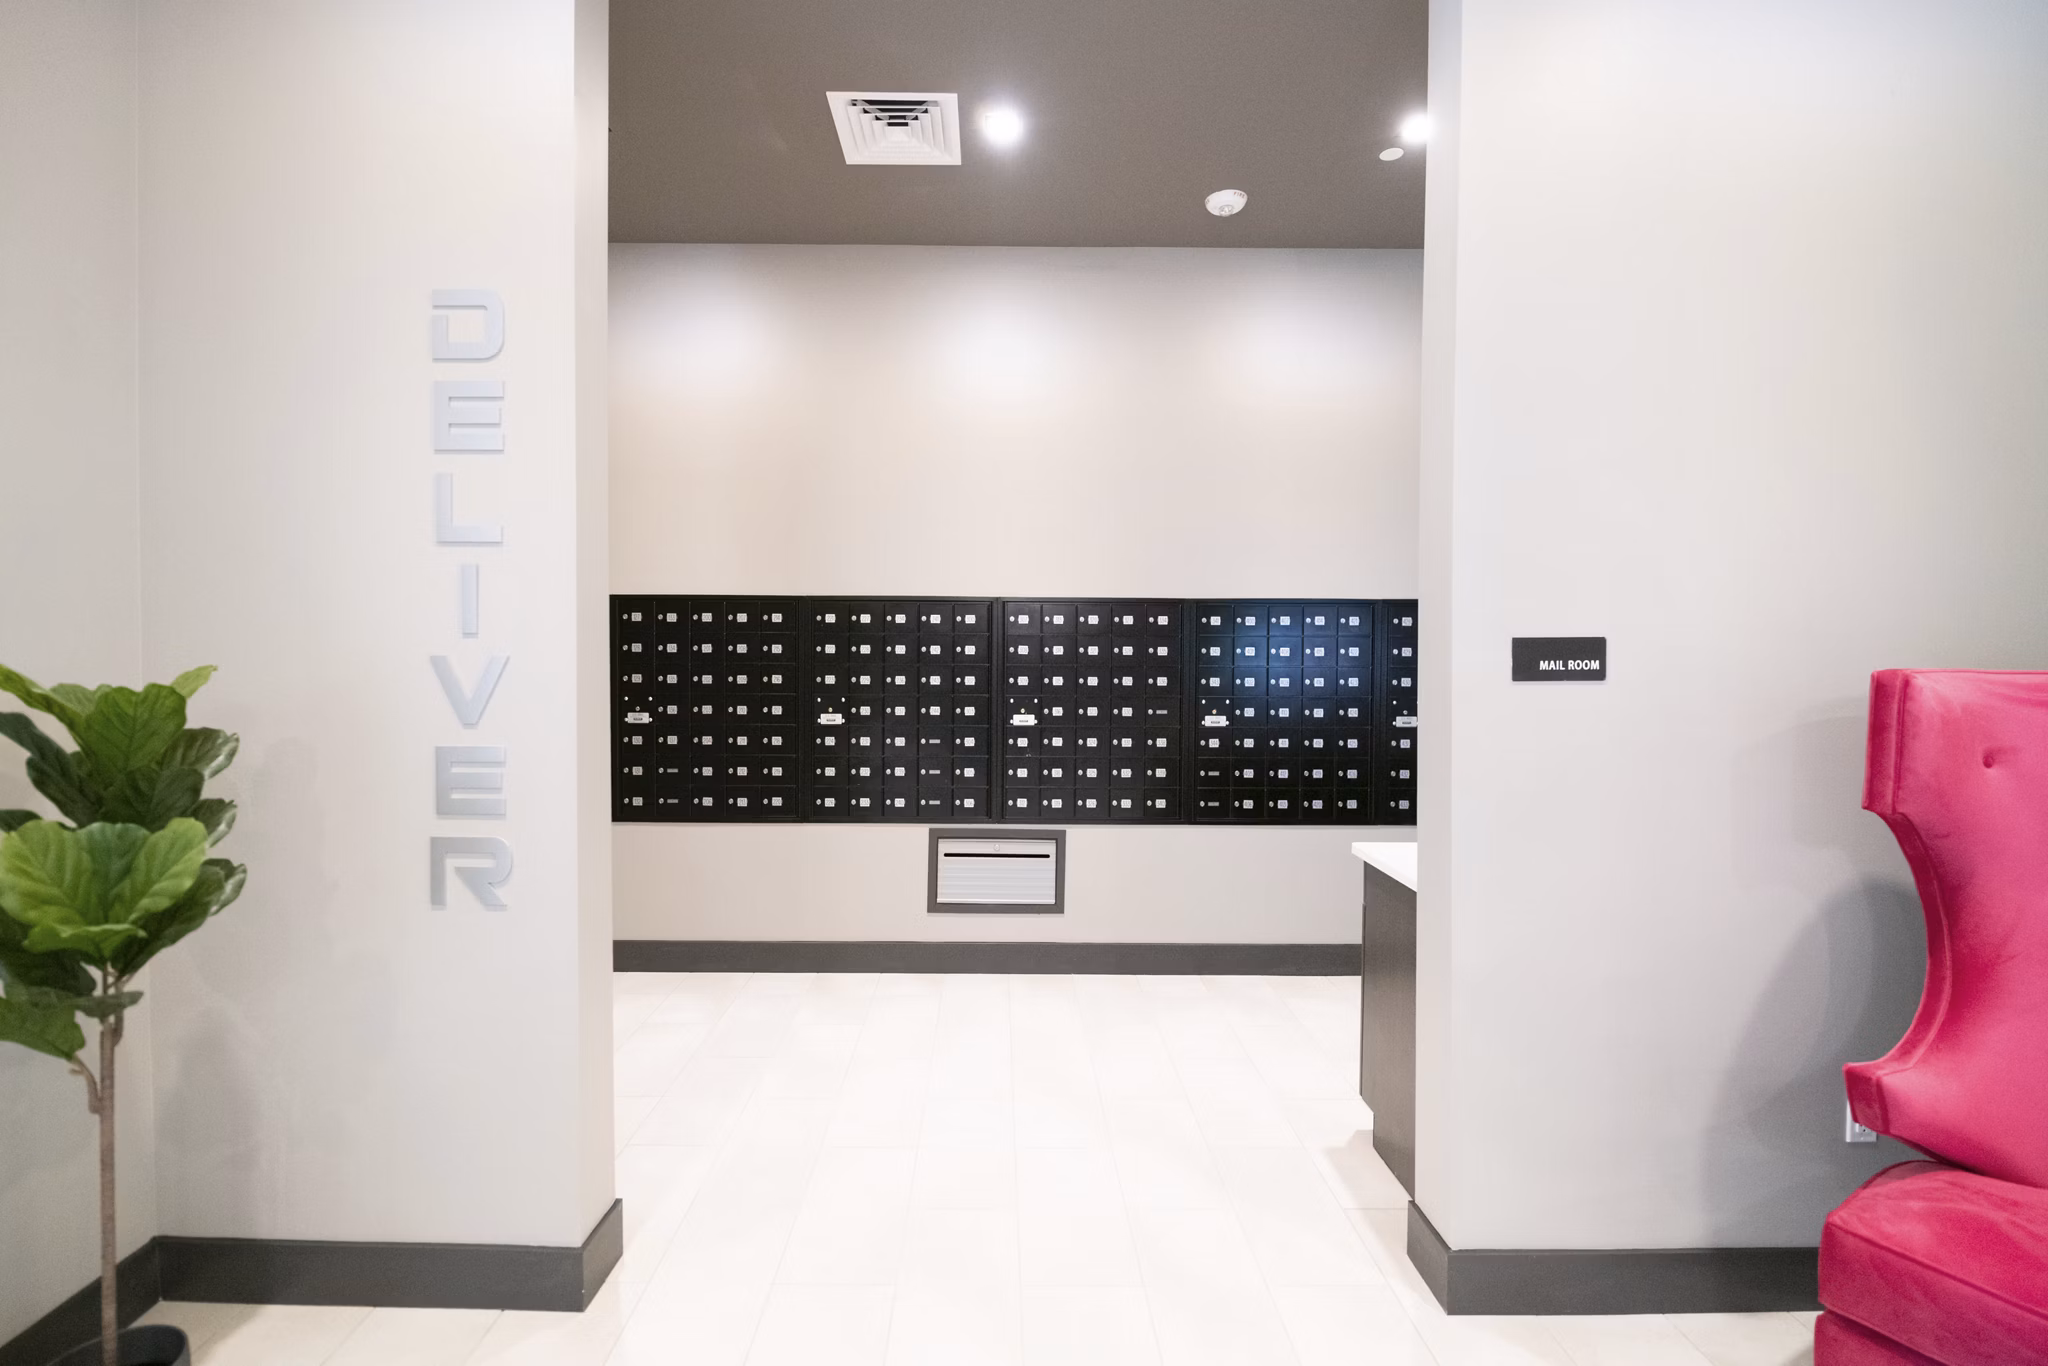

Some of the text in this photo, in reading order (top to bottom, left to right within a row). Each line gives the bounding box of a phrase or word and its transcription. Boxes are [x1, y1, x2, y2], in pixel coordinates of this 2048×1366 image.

[431, 289, 514, 911] DELIVER
[1539, 660, 1600, 670] MAIL ROOM
